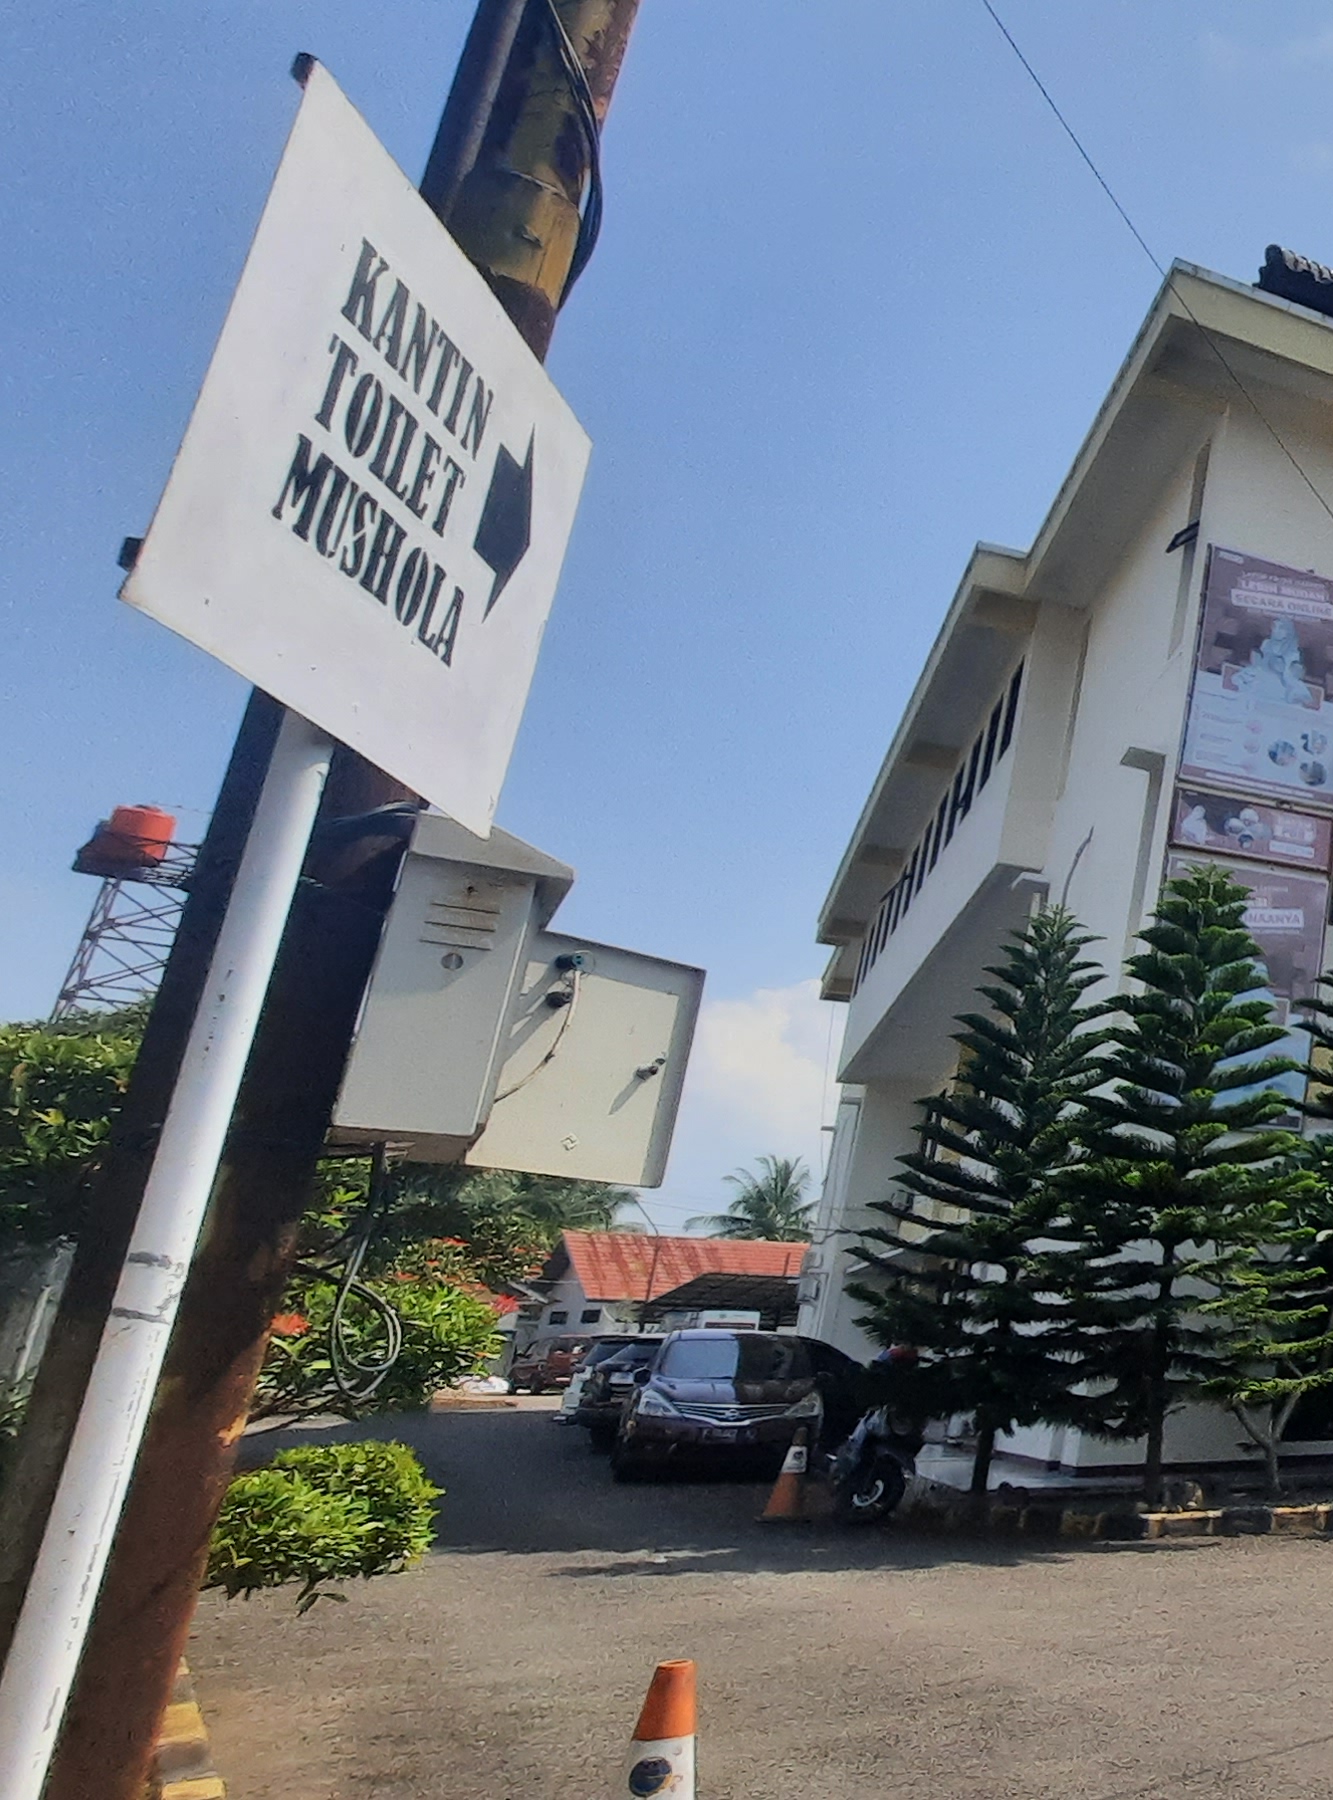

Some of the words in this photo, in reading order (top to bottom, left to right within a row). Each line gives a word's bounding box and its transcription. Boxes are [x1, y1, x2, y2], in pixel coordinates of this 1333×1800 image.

[315, 333, 467, 538] TOILET
[341, 237, 494, 461] KANTIN
[271, 433, 465, 668] MUSHOLA
[1235, 594, 1285, 609] SECARA
[1287, 602, 1332, 617] ONLINE
